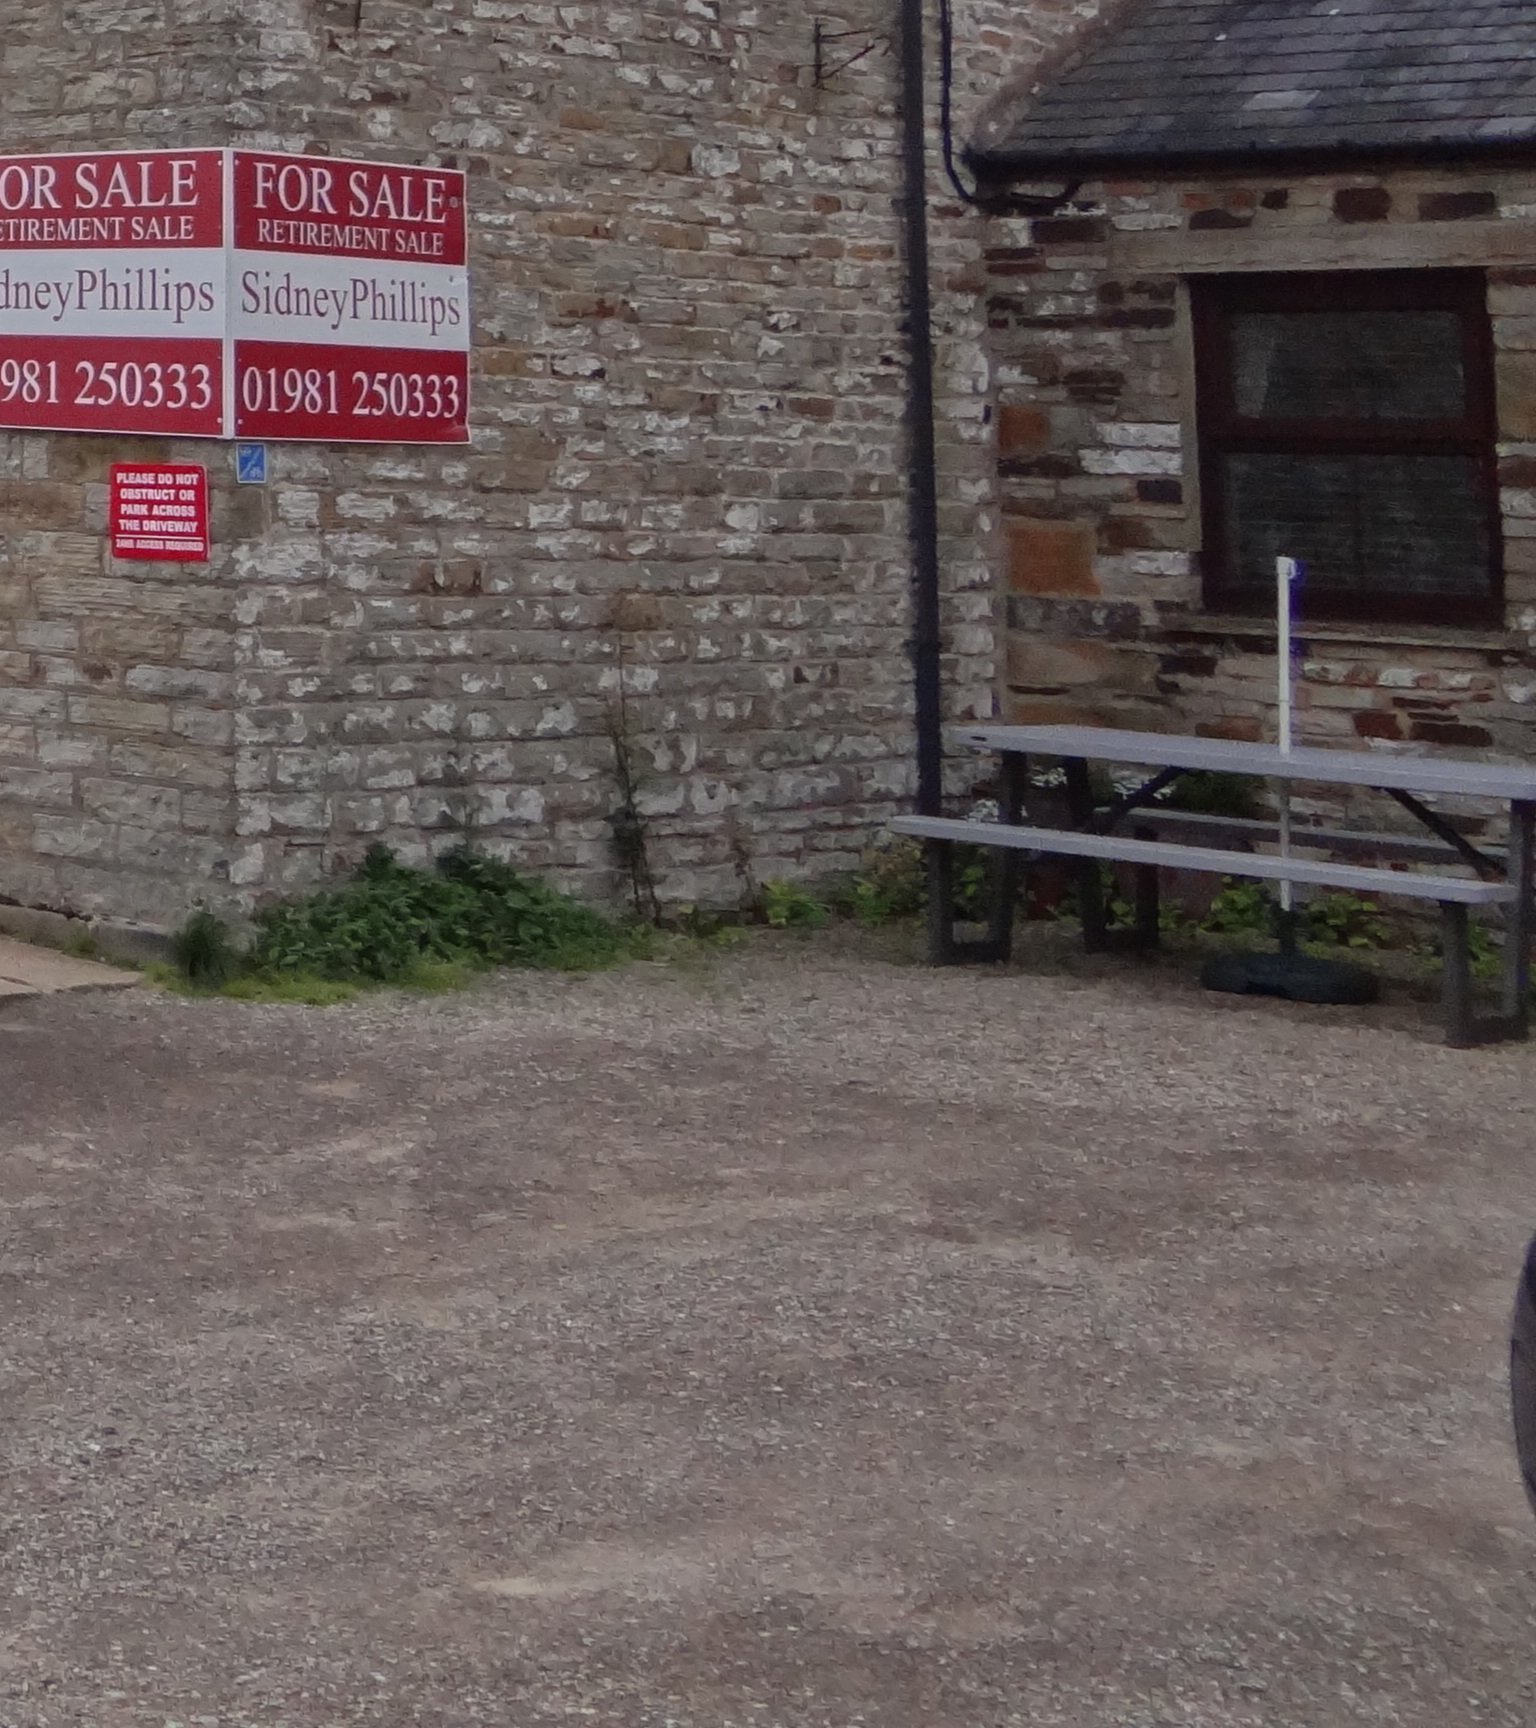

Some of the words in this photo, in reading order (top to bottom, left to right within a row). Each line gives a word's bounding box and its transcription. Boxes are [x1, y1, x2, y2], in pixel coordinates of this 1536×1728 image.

[76, 160, 199, 209] SALE
[253, 162, 338, 215] FOR
[349, 170, 447, 224] SALE
[131, 216, 194, 240] SALE
[257, 218, 391, 252] RETIREMENT
[395, 228, 444, 256] SALE
[74, 361, 212, 410] 250333
[243, 366, 340, 415] 01981
[351, 370, 460, 419] 250333
[116, 473, 155, 485] PLEASE
[157, 474, 173, 485] DO
[175, 474, 199, 486] NOT
[120, 488, 176, 501] OBSTRUCT
[179, 489, 195, 501] OR
[118, 519, 140, 531] THE
[142, 520, 198, 533] DRIVEWAY
[120, 504, 149, 516] PARK
[151, 504, 196, 517] ACROSS
